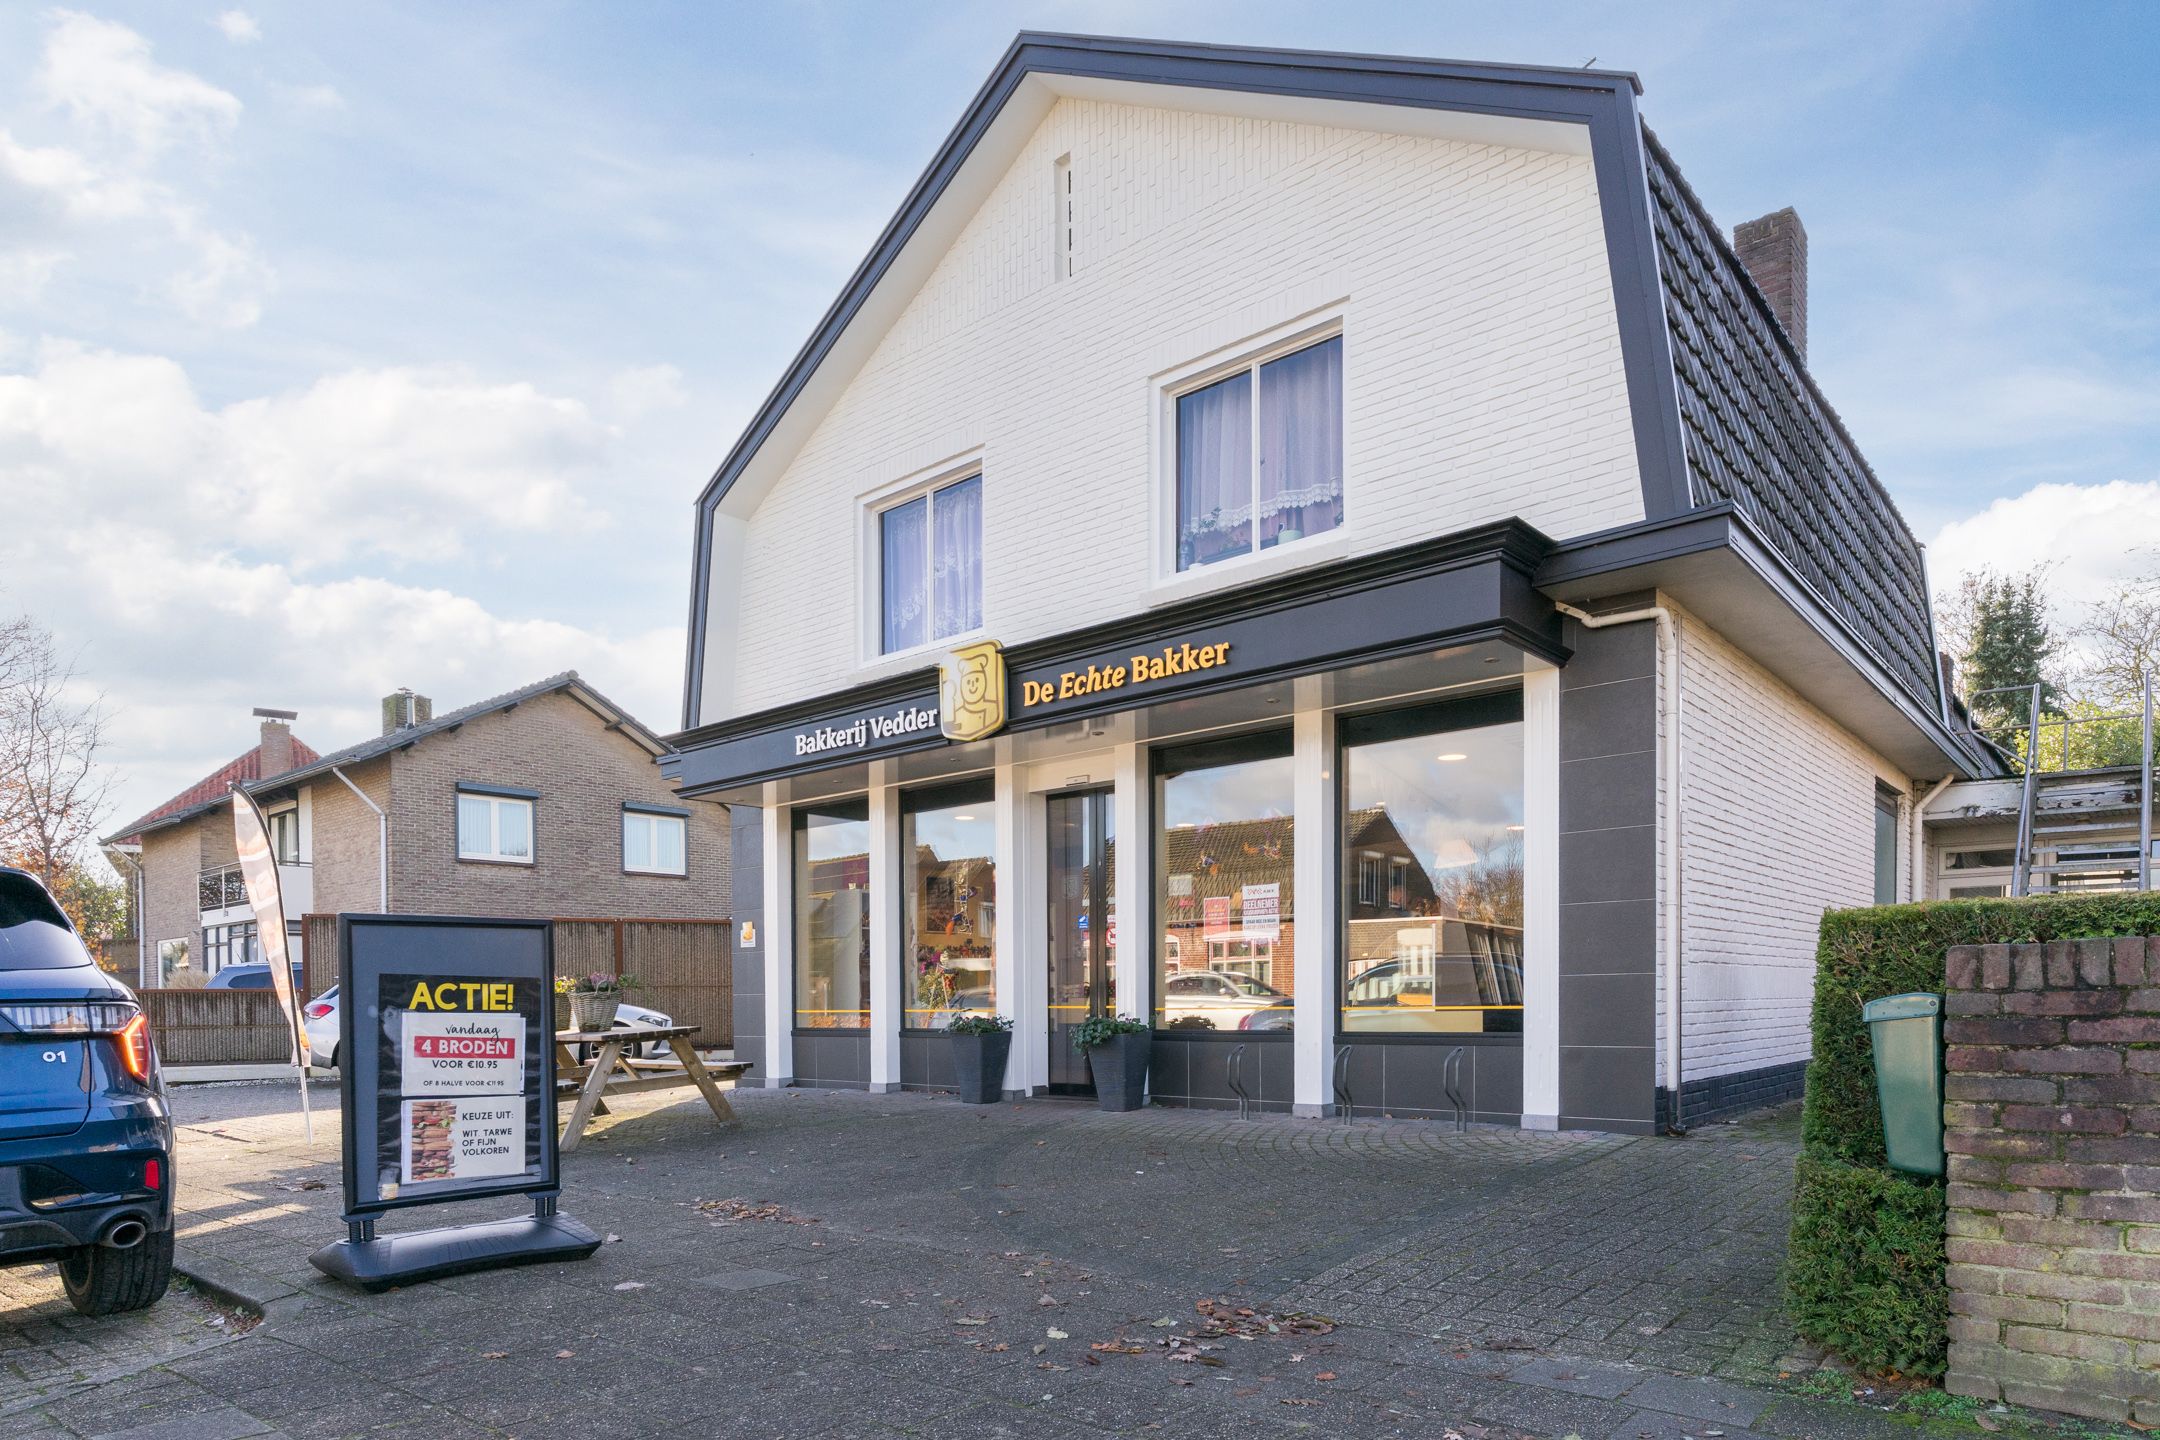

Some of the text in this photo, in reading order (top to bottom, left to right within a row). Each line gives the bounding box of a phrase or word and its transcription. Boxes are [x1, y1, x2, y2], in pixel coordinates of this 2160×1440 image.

[1023, 642, 1229, 707] De Echte Bakker
[795, 707, 938, 756] Bakkerij Vedder
[408, 982, 514, 1011] ACTIE!
[445, 1022, 500, 1044] vandaag
[421, 1039, 508, 1054] 4 BRODEN
[42, 1050, 67, 1063] 01
[432, 1060, 498, 1069] VOOR €10.95
[462, 1110, 514, 1121] KEUZE UIT:
[483, 1127, 513, 1137] TARWE
[462, 1138, 497, 1147] OF FIJN
[462, 1146, 510, 1156] VOLKOREN
